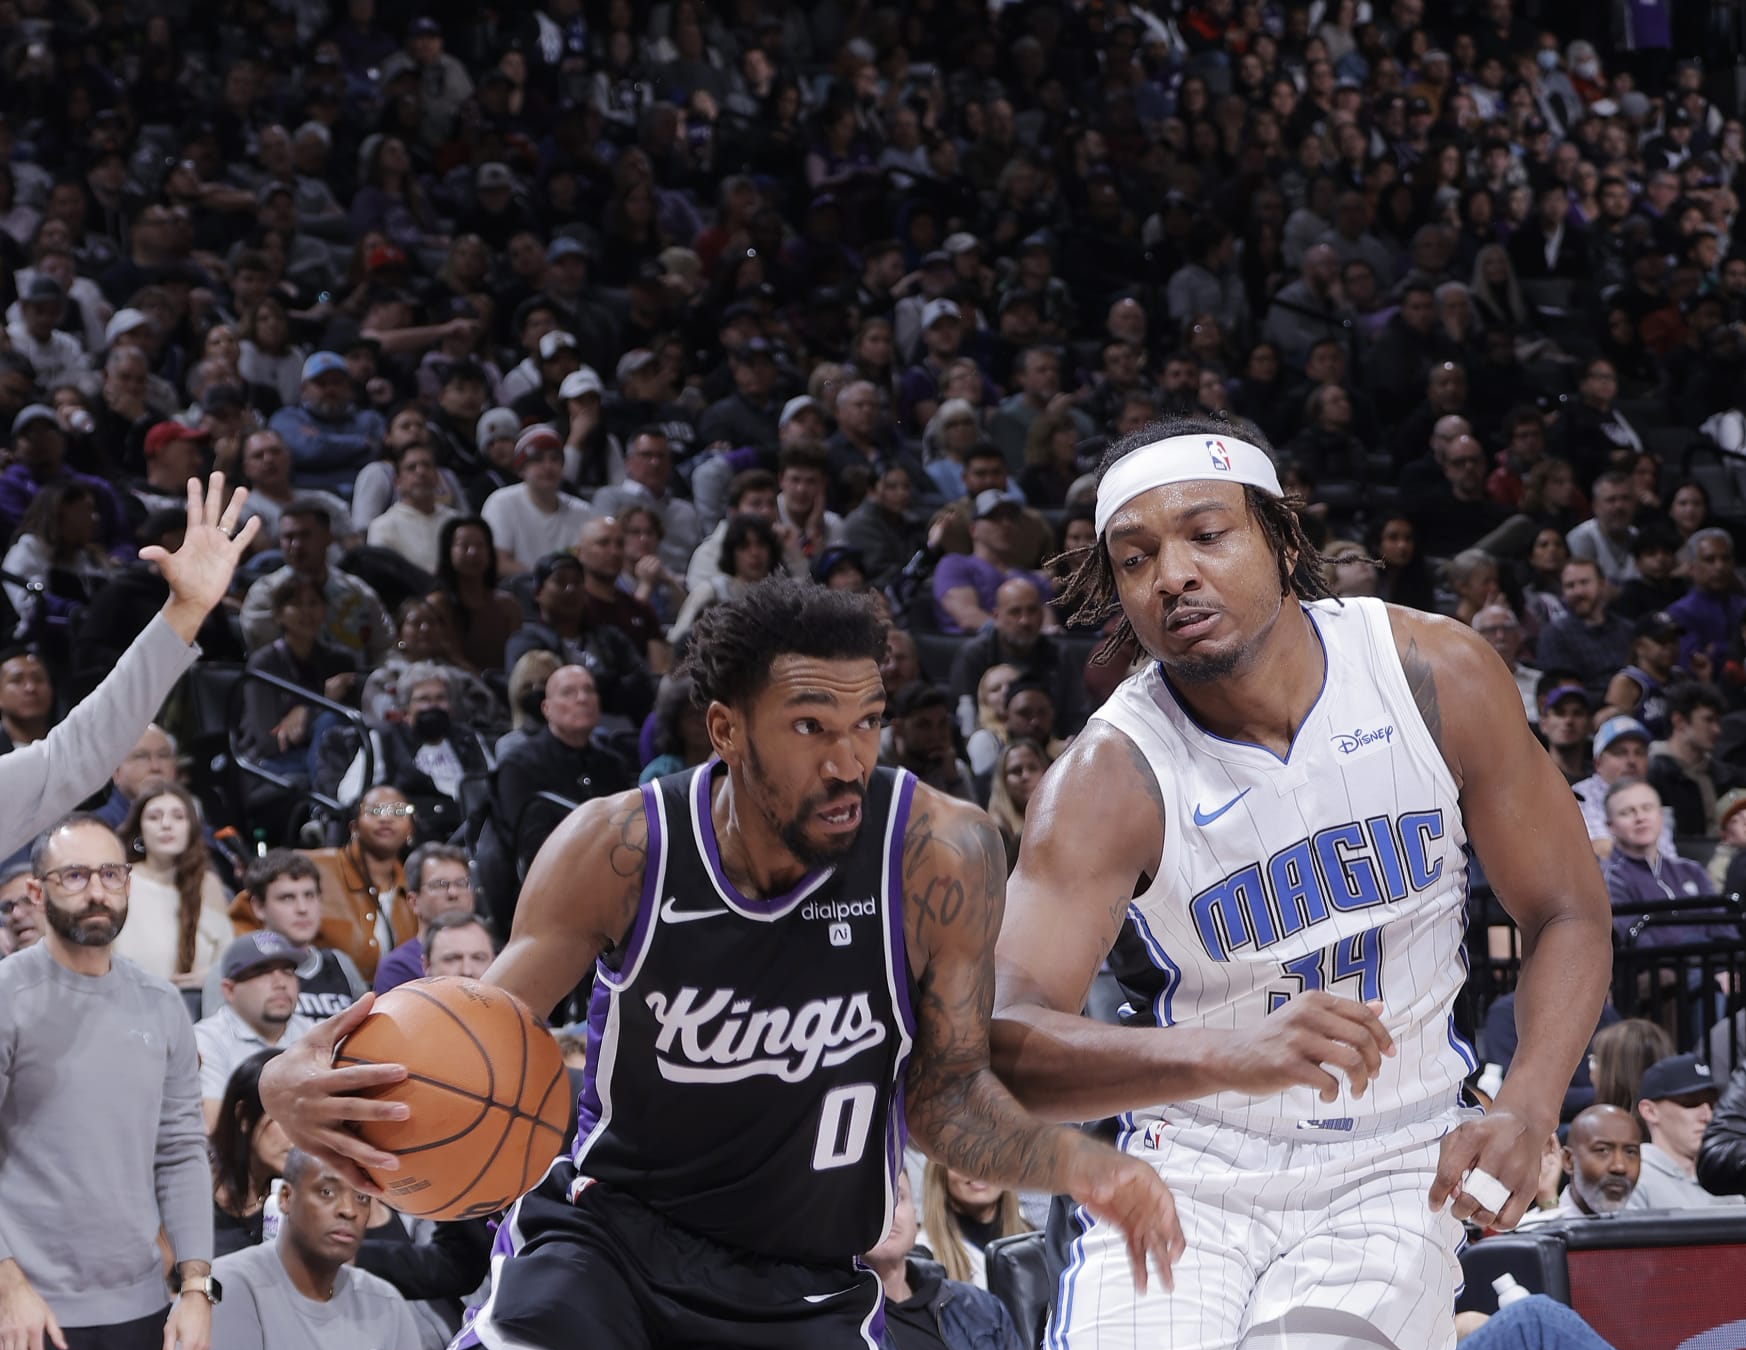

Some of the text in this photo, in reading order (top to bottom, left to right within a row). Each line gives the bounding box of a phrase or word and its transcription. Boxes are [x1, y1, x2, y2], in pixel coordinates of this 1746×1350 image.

[801, 897, 876, 922] dialpad
[1189, 808, 1445, 962] MAGIC
[645, 985, 886, 1083] Kings
[810, 1082, 879, 1172] 0
